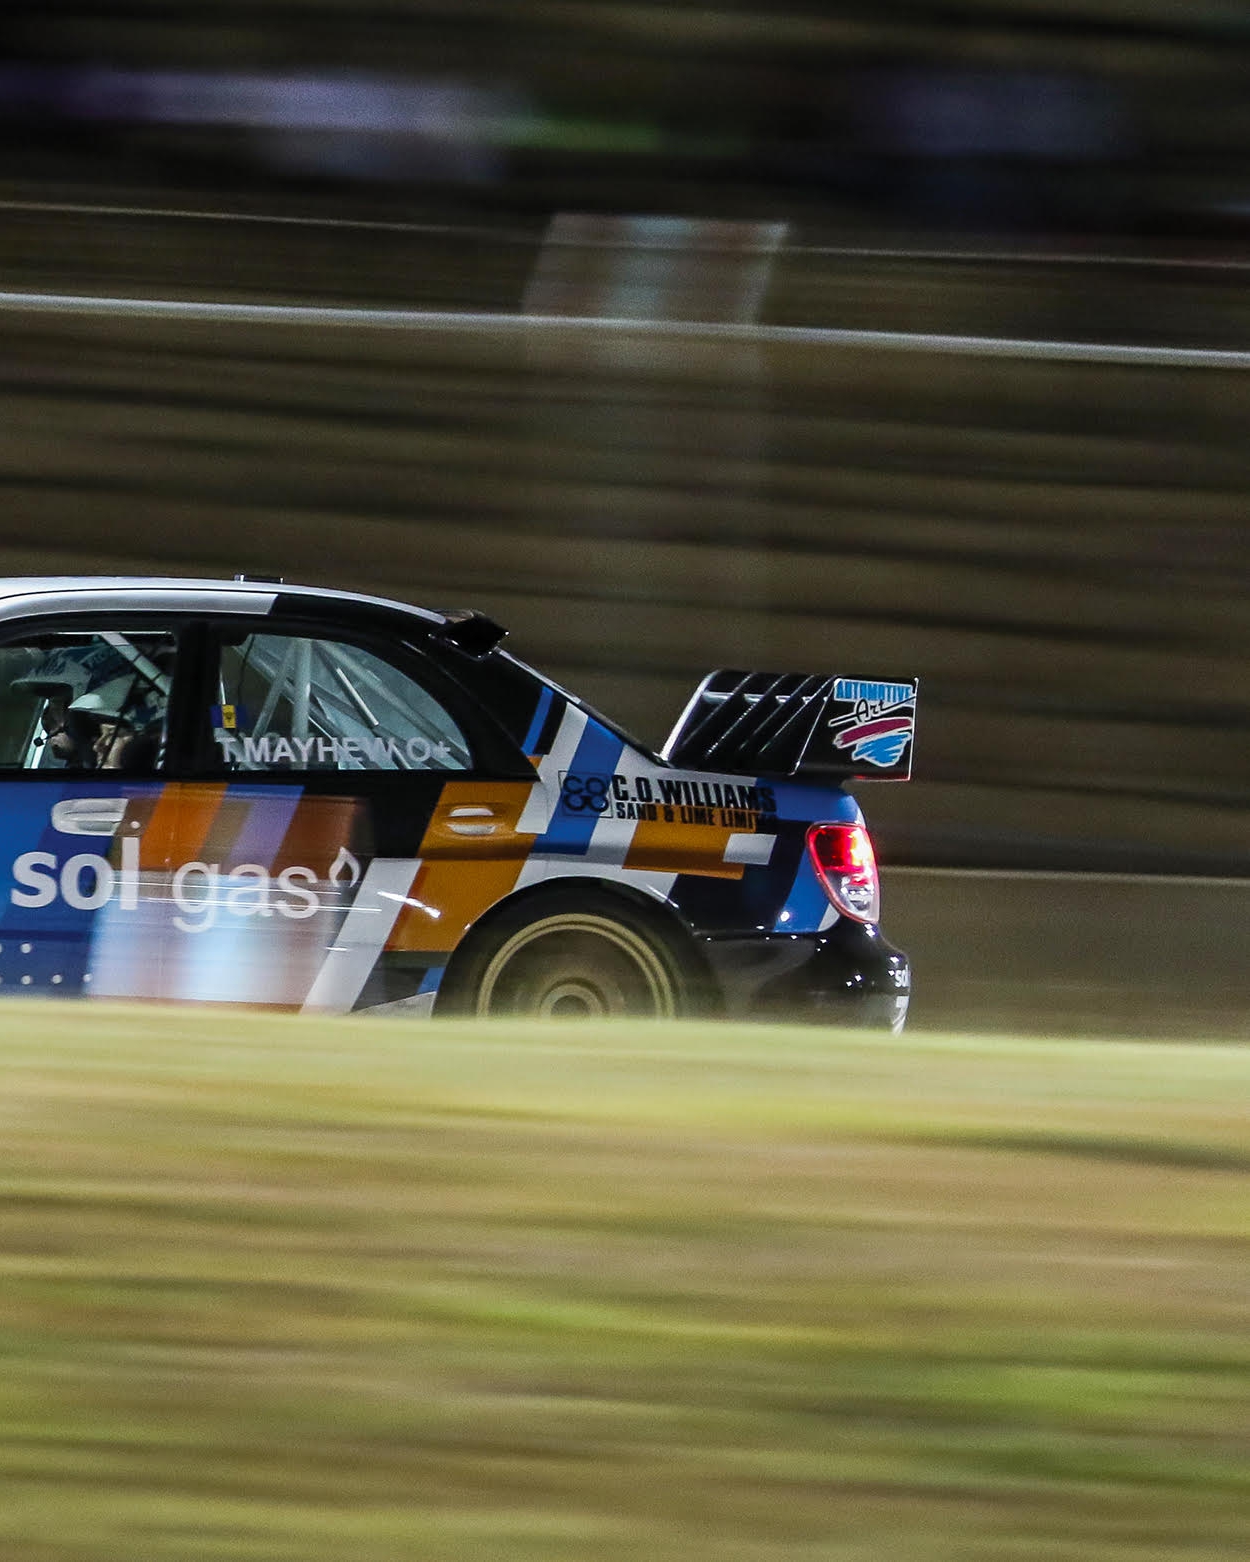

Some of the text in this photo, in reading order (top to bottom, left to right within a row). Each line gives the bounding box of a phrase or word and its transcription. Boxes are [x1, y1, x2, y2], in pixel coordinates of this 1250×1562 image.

[616, 802, 658, 821] SAND
[680, 806, 716, 826] LIME
[11, 837, 320, 933] sol gas
